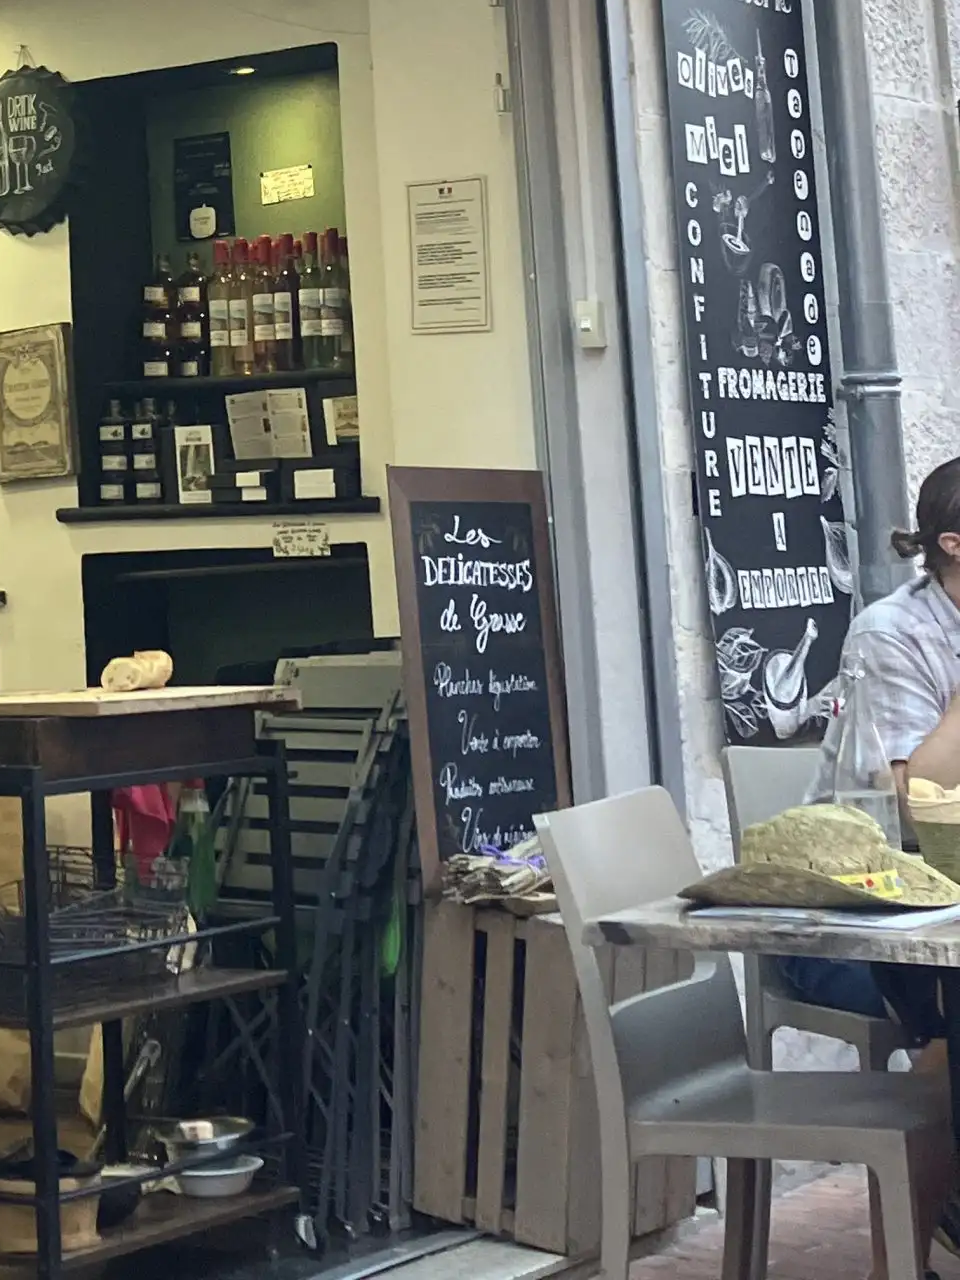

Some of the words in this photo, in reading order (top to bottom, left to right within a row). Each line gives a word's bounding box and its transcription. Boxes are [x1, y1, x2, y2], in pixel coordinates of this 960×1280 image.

[8, 94, 37, 118] DRINK
[8, 116, 37, 132] WINE
[687, 119, 749, 173] Miel
[685, 181, 722, 517] CONFITURE
[717, 367, 827, 403] FROMAGERIE
[728, 438, 819, 495] VENTE
[444, 515, 502, 548] Les
[739, 568, 833, 606] EMPORTER
[440, 599, 461, 632] de
